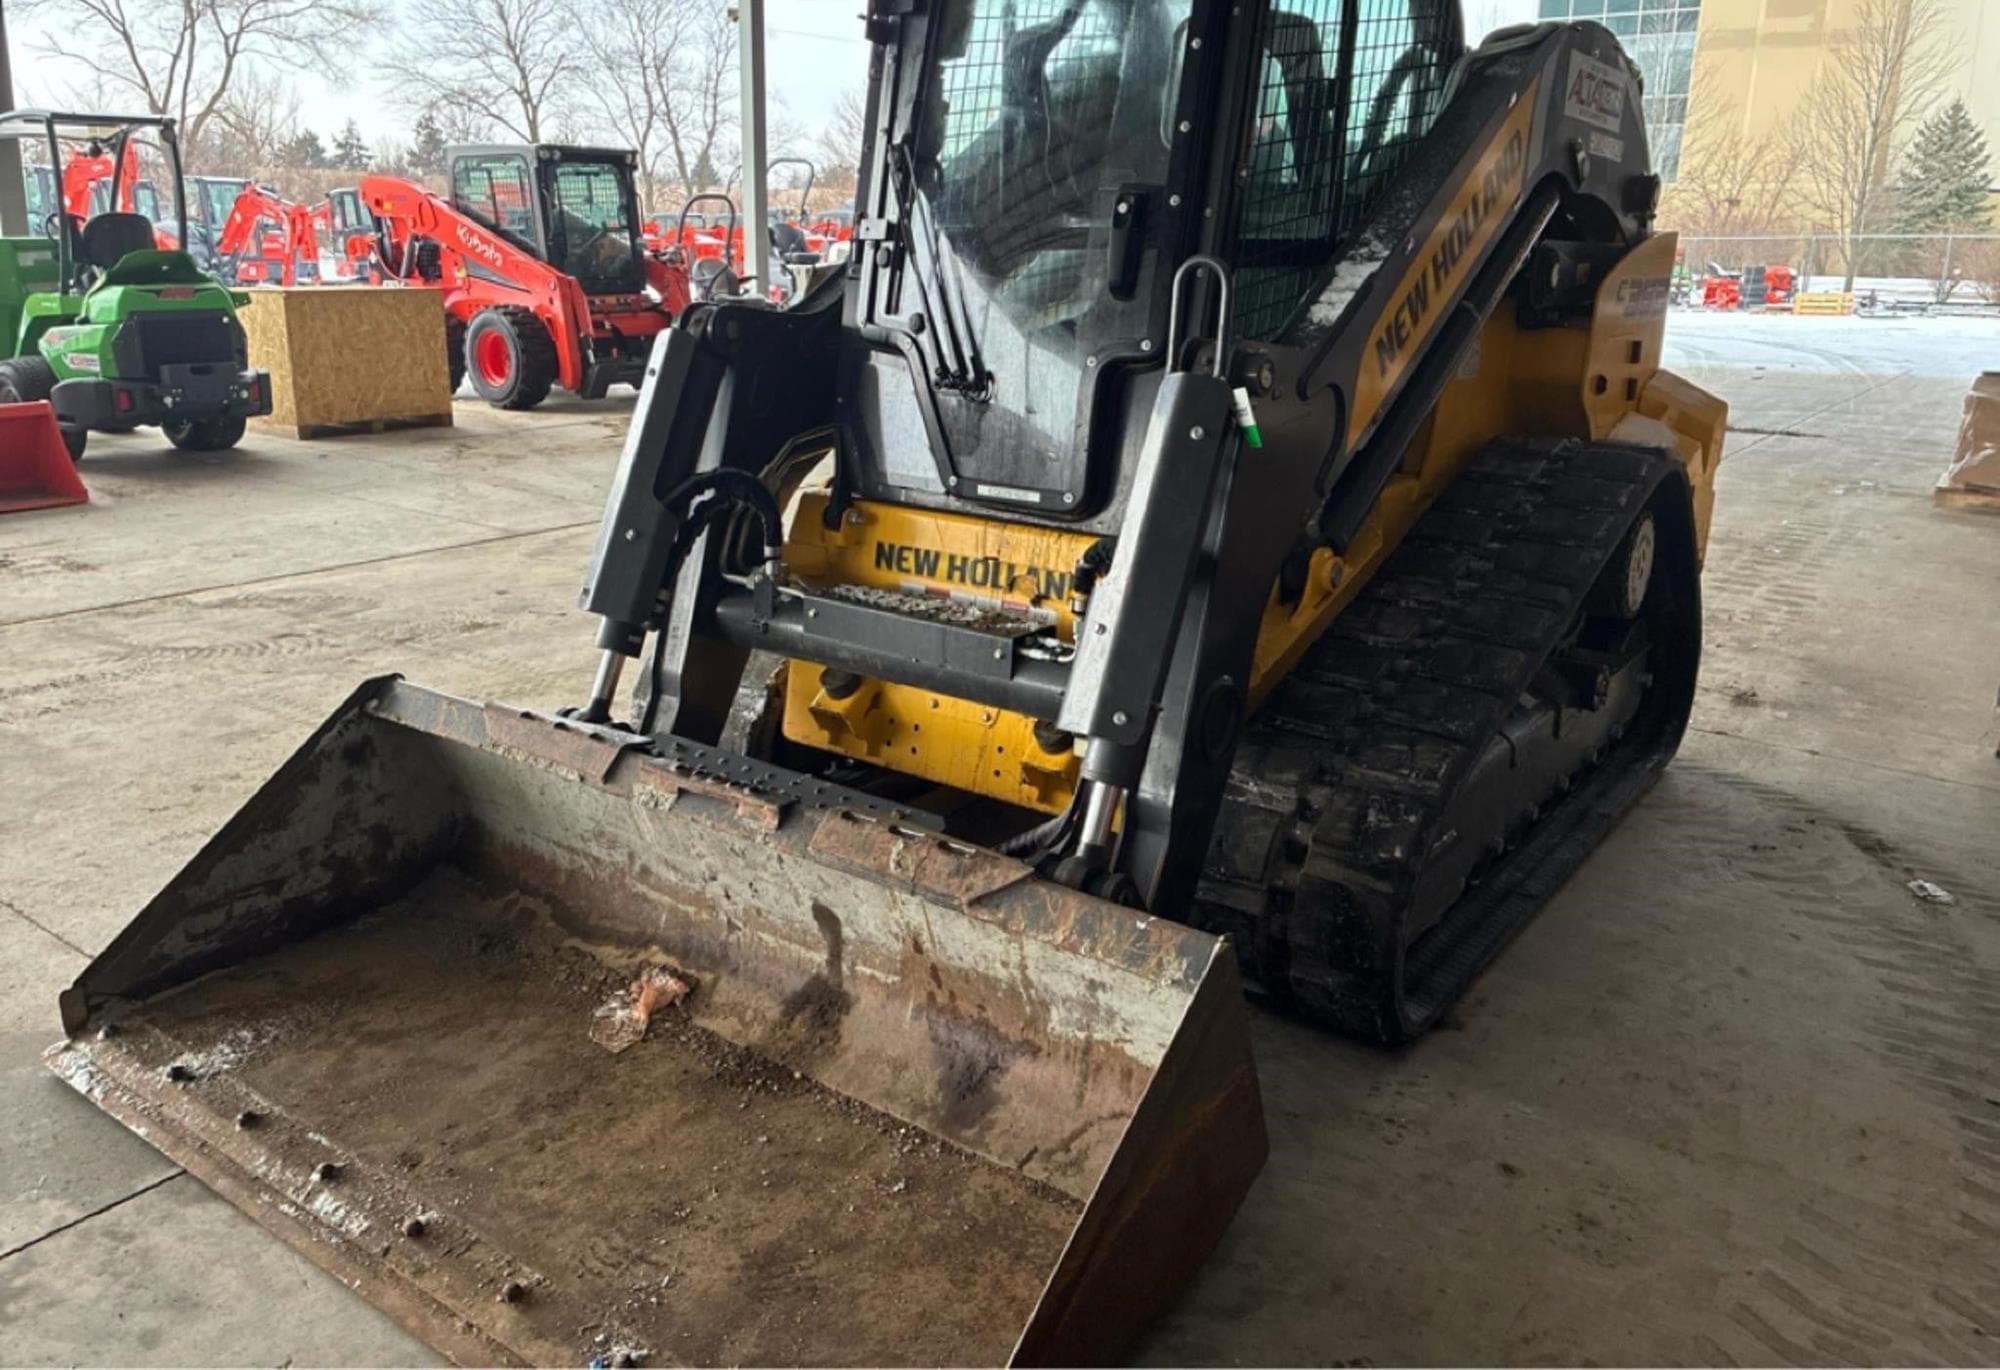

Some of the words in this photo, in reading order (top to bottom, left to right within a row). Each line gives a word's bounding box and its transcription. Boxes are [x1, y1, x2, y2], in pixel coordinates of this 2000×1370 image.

[457, 223, 503, 267] Kubota
[1375, 269, 1429, 378] NEW
[1432, 128, 1523, 293] HOLLAND
[875, 541, 940, 577] NEW
[946, 553, 1074, 601] HOLLAN
